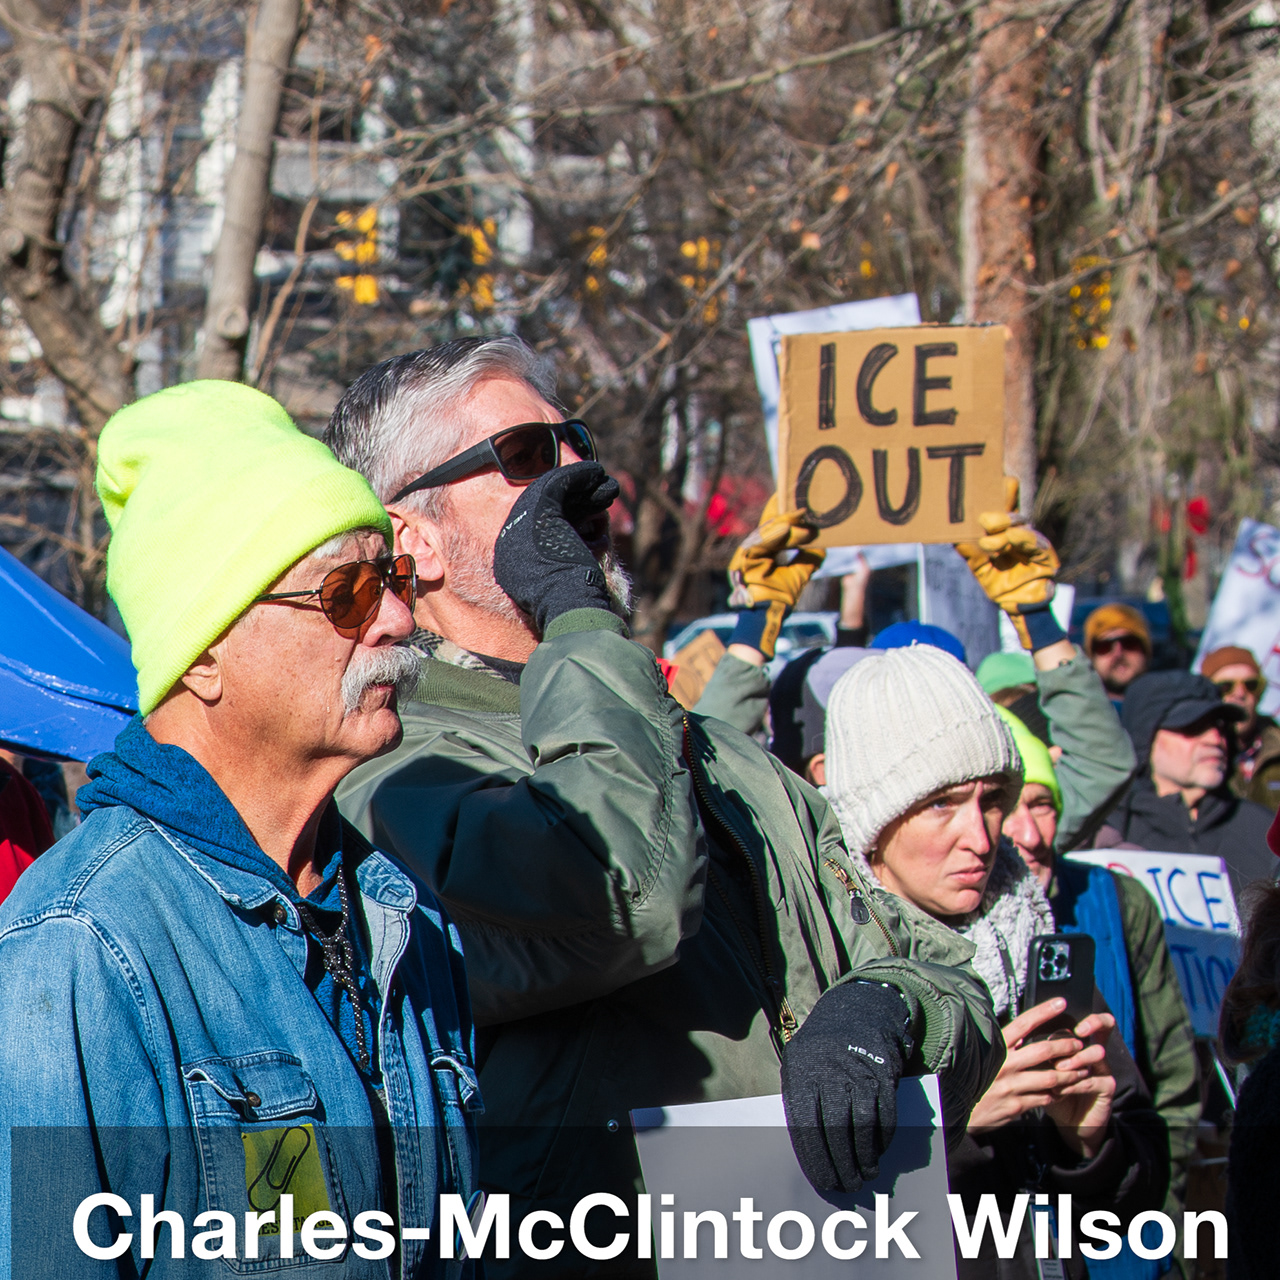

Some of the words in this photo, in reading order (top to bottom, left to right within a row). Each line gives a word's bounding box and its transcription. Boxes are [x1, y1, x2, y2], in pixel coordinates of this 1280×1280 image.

[818, 341, 959, 430] ICE
[794, 442, 987, 530] OUT
[500, 509, 529, 538] HEAD
[1146, 867, 1231, 930] ICE
[847, 1043, 886, 1065] HEAD
